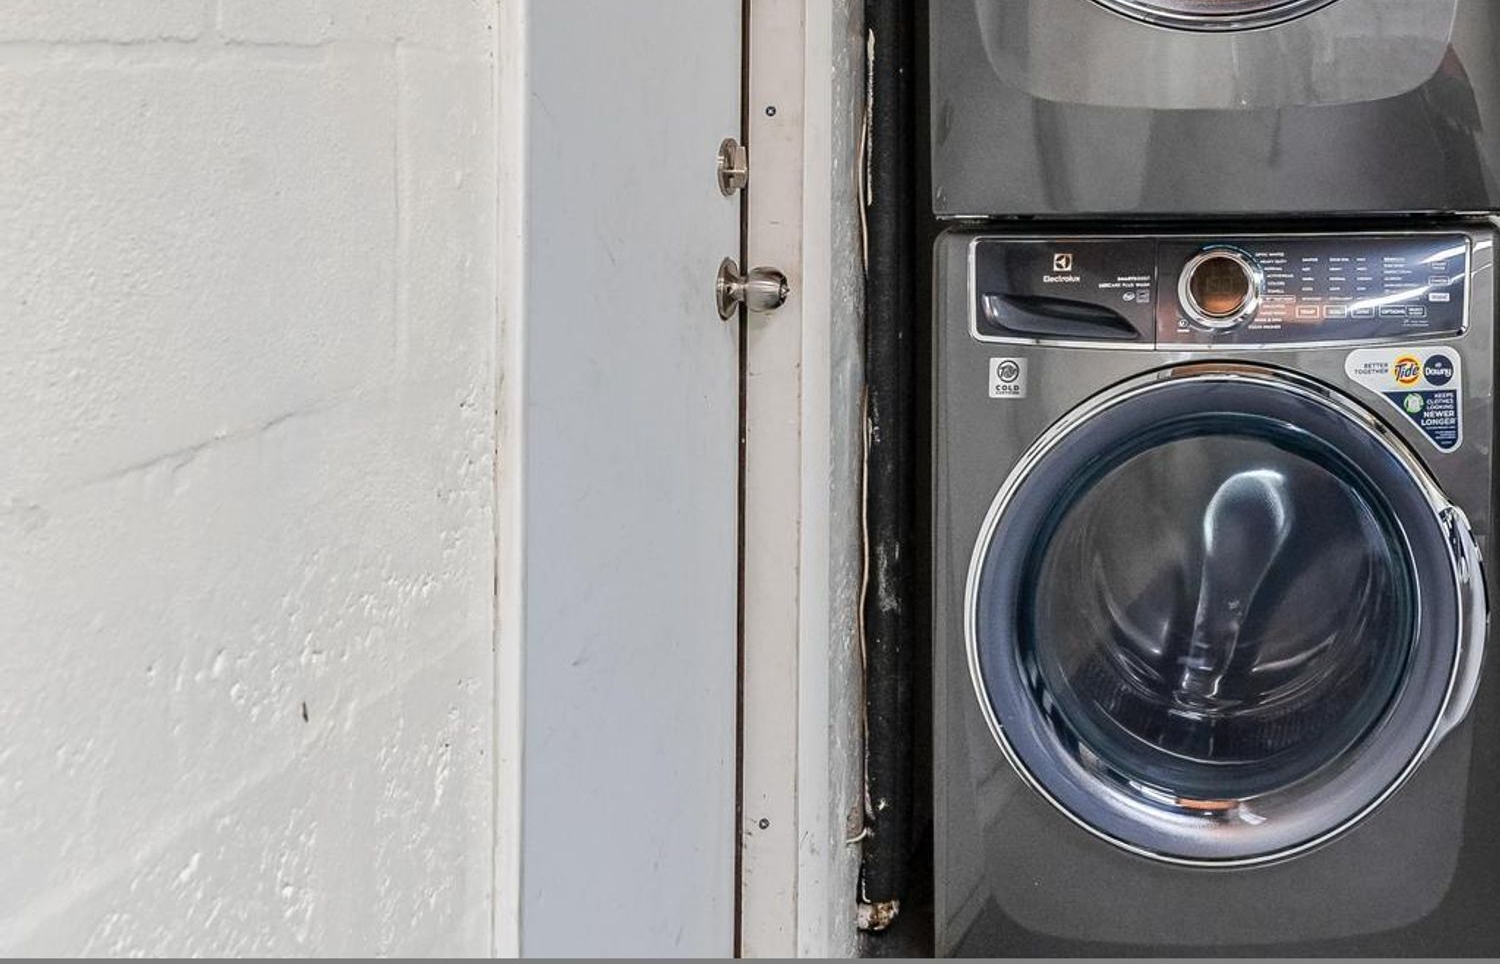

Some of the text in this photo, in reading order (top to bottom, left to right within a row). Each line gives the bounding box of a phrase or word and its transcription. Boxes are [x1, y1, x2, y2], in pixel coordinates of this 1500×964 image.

[1043, 275, 1080, 284] Electrolux
[1394, 363, 1420, 381] Tide
[1425, 367, 1452, 378] Downy
